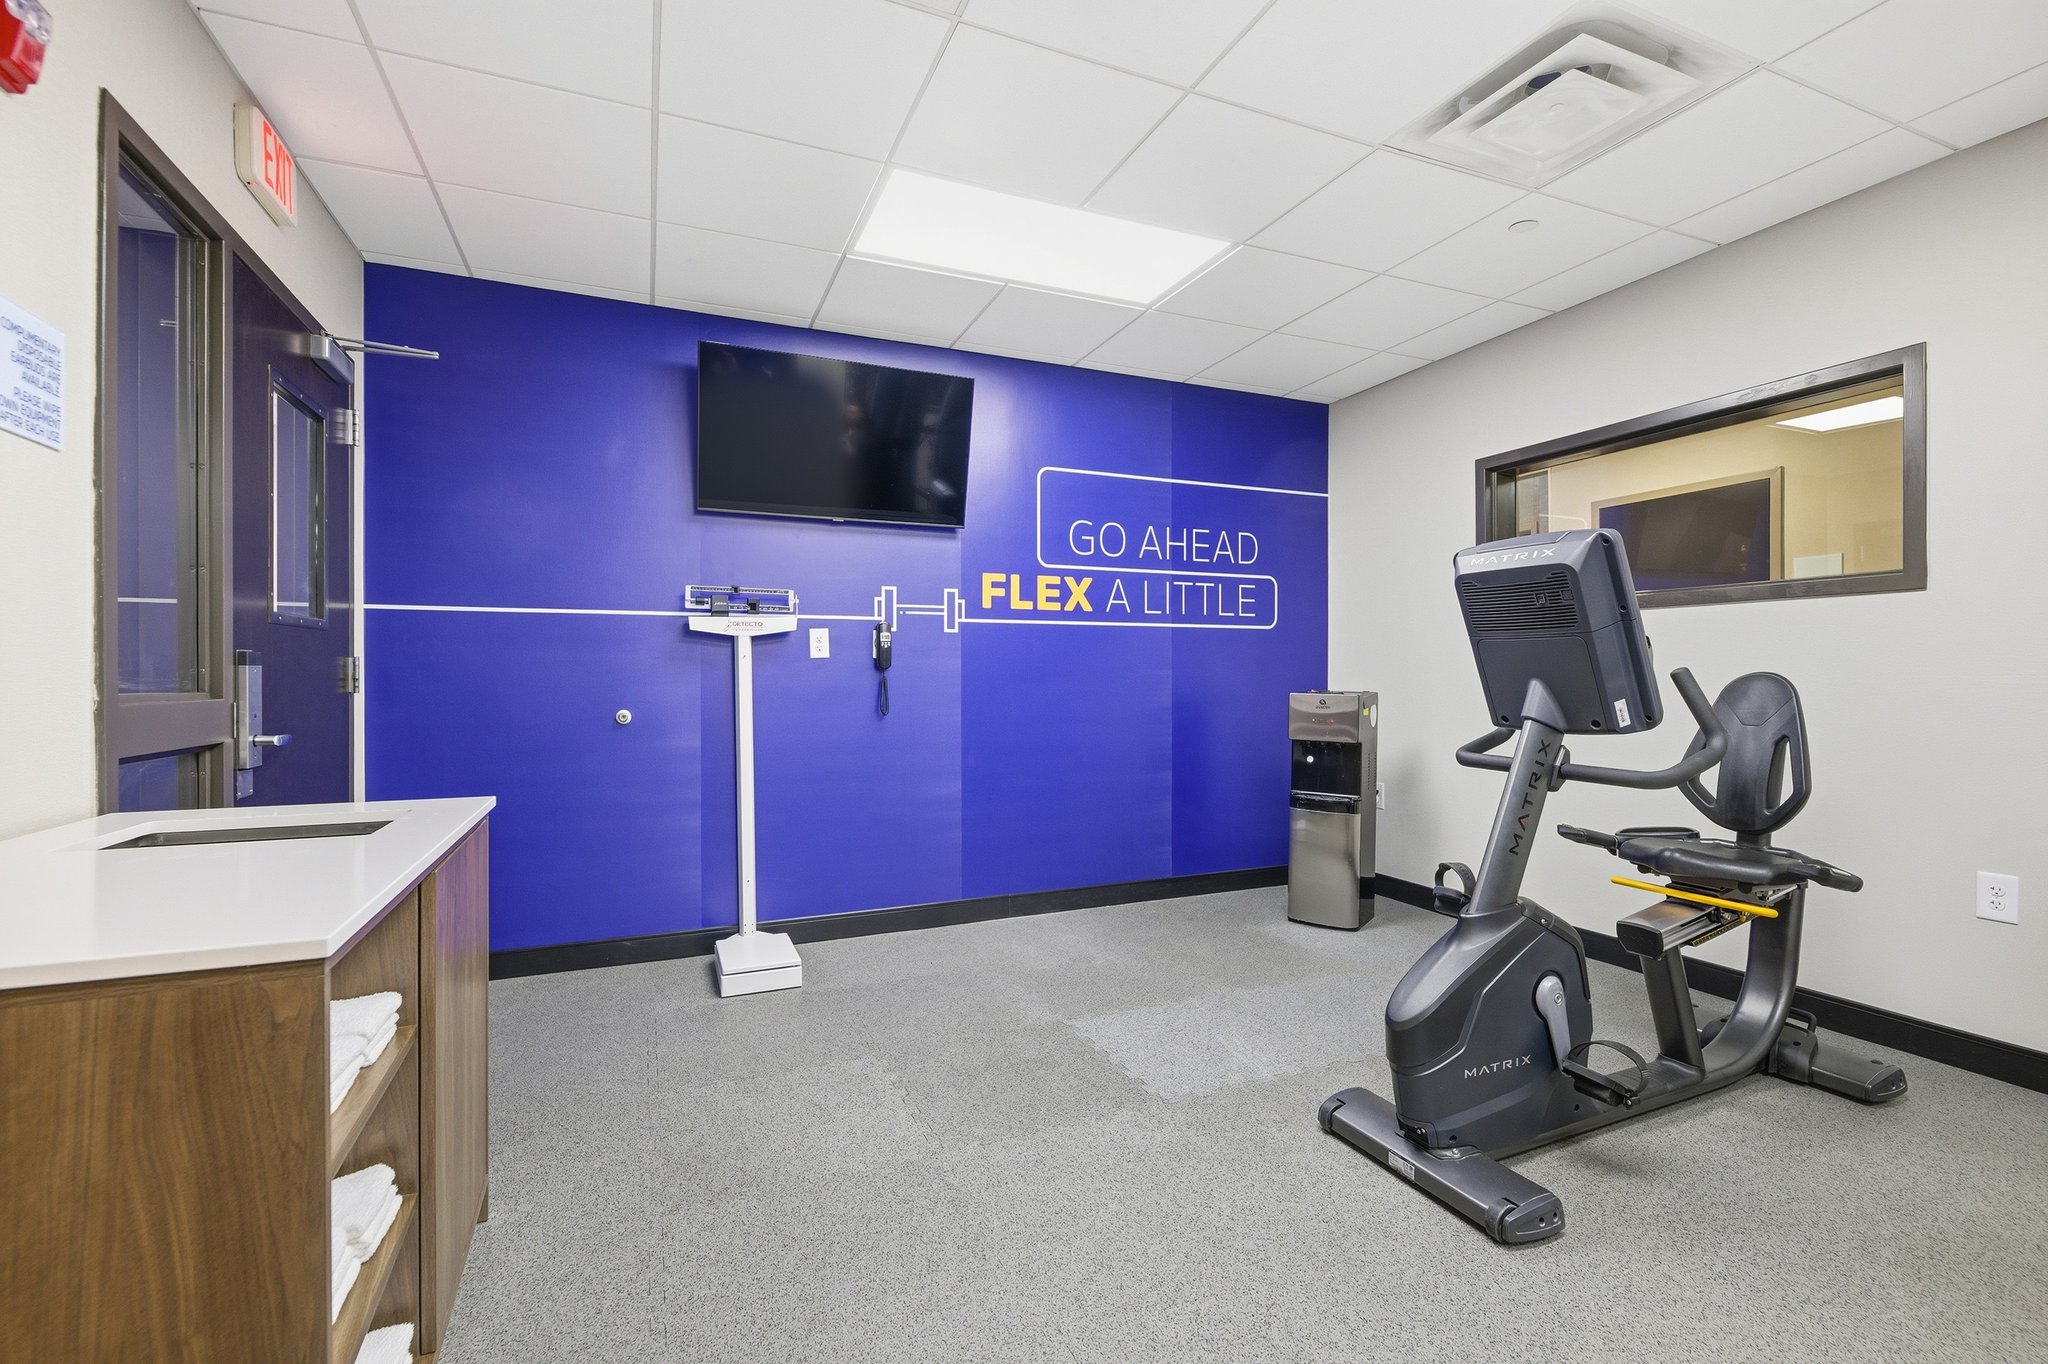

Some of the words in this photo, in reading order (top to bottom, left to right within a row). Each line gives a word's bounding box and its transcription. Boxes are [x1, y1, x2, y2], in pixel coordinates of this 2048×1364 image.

[262, 119, 293, 215] EXIT
[0, 316, 61, 357] COMPLIMENTARY
[10, 350, 46, 377] EARBUDS
[47, 369, 61, 386] ARE
[17, 339, 61, 371] DISPOSABLE
[13, 386, 41, 409] PLEASE
[43, 401, 61, 418] WIPE
[21, 371, 61, 398] AVAILABLE
[0, 393, 19, 413] OWN
[20, 403, 61, 430] EQUIPMENT
[25, 419, 45, 437] EACH
[47, 429, 61, 444] USE
[1069, 519, 1127, 557] GO
[1138, 525, 1259, 564] AHEAD
[1470, 546, 1558, 566] MATRIX
[981, 572, 1093, 612] FLEX
[1106, 578, 1131, 614] A
[1144, 580, 1256, 617] LITTLE
[1508, 739, 1551, 856] MATRIX
[1464, 1054, 1531, 1079] MATRIX
